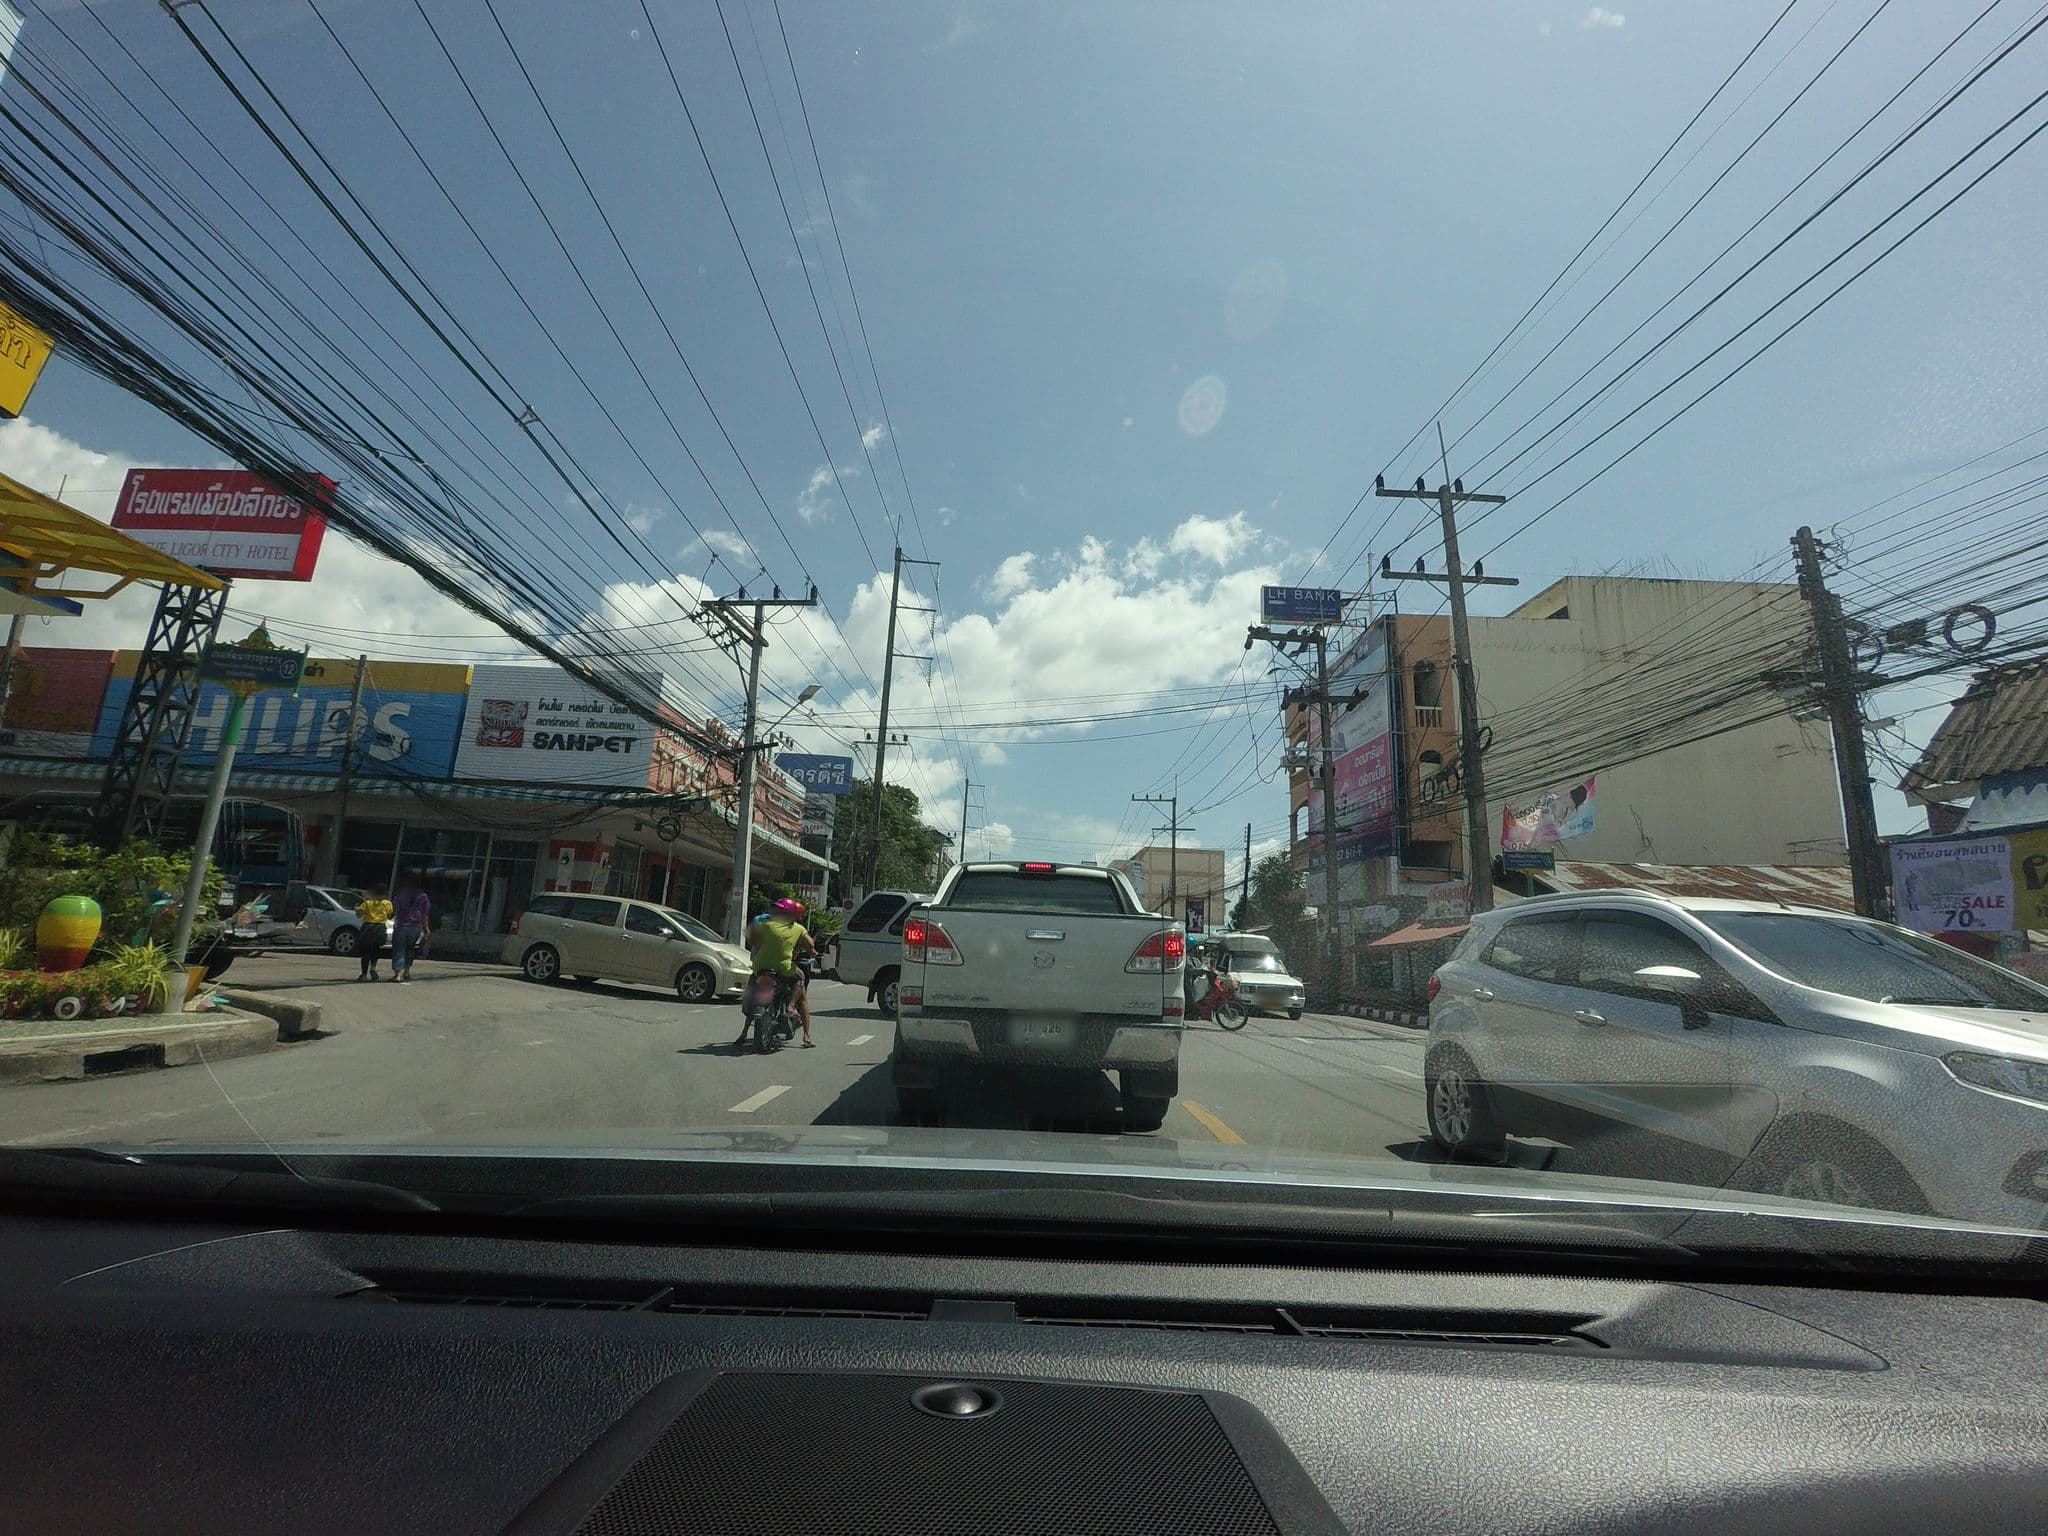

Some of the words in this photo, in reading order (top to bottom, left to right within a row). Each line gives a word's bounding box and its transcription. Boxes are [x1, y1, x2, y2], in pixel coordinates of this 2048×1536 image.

[170, 542, 209, 556] LIGOR
[212, 543, 240, 558] CITY
[248, 545, 290, 560] HOTEL
[1268, 588, 1287, 599] LH
[1294, 590, 1336, 602] BANK
[532, 732, 637, 753] SANPET
[1962, 895, 2005, 909] SALE
